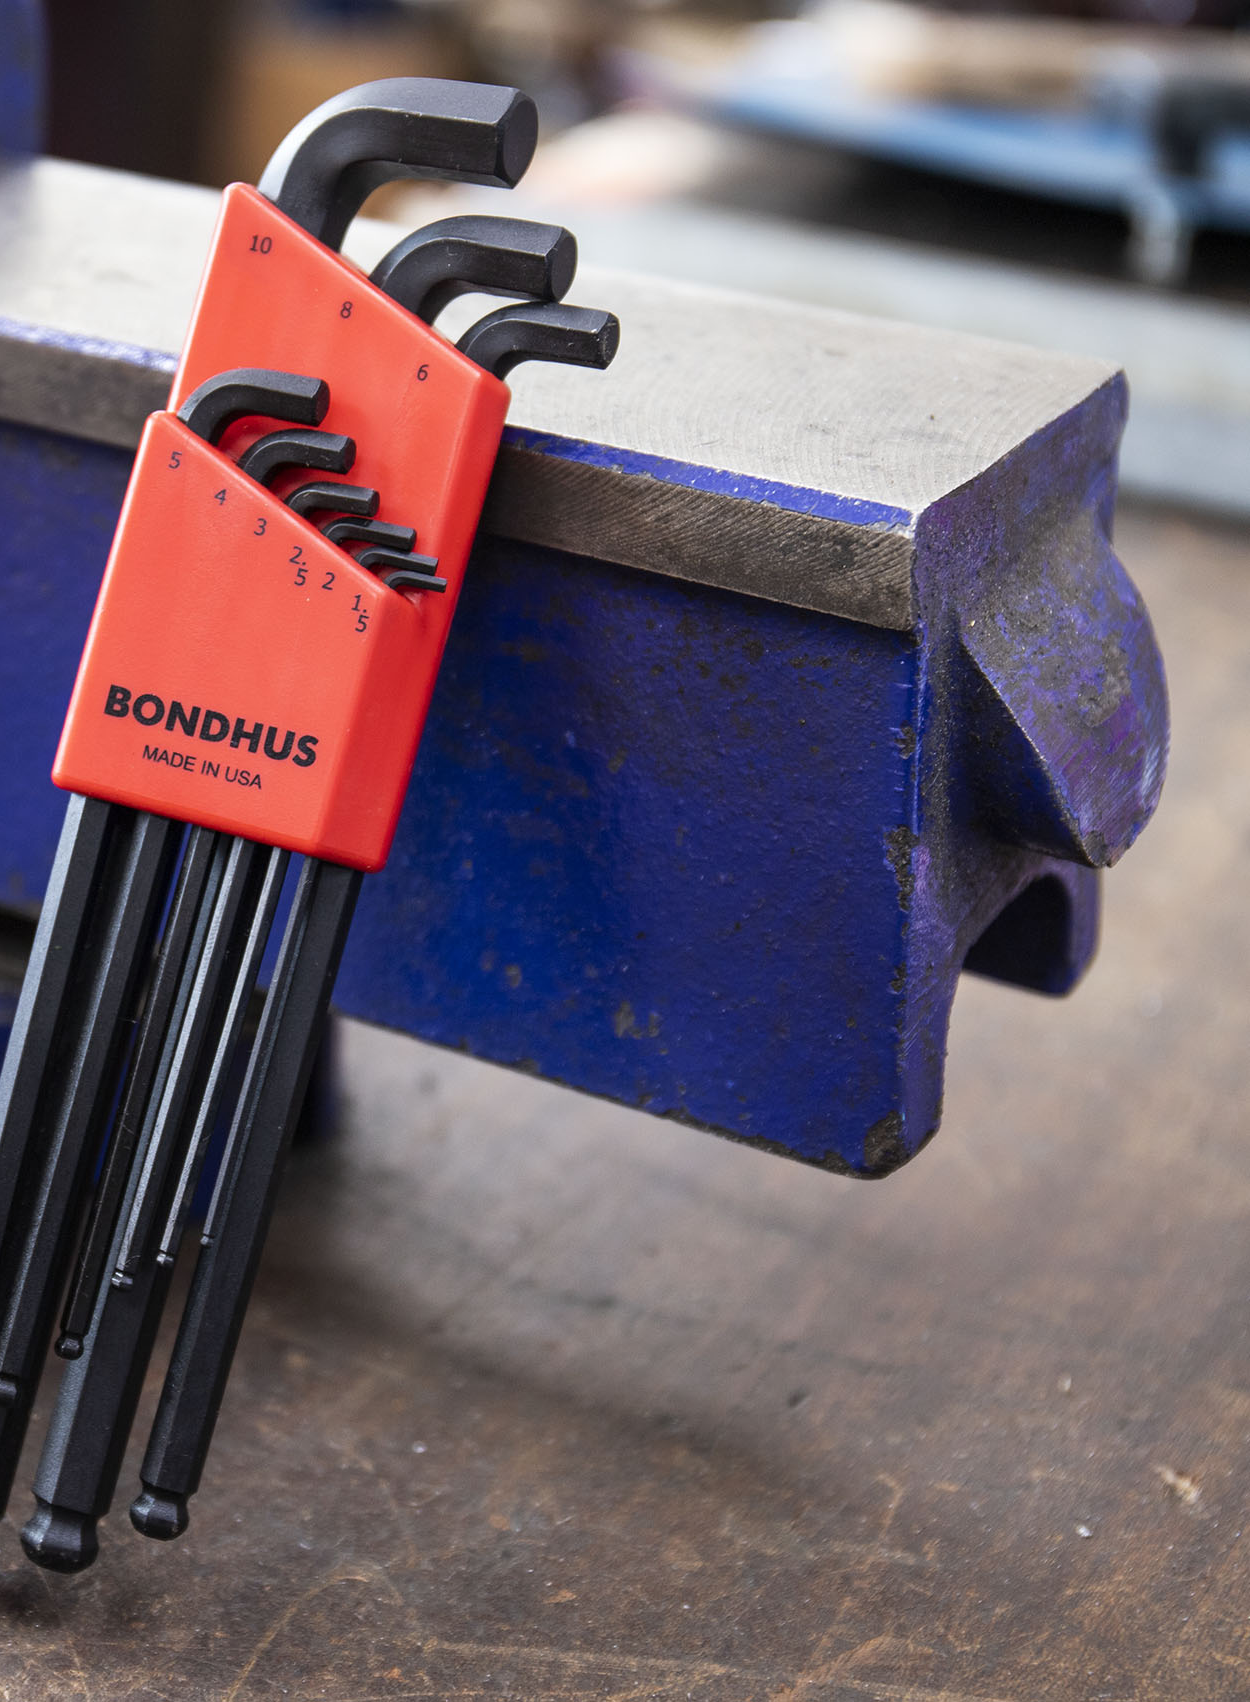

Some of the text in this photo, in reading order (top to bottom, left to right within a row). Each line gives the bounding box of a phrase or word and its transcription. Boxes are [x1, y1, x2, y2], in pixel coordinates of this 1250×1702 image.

[249, 235, 273, 255] 10
[340, 301, 353, 319] 8
[416, 364, 429, 382] 6
[168, 451, 182, 469] 5
[214, 488, 227, 505] 4
[253, 518, 267, 536] 3
[321, 572, 336, 590] 2
[103, 684, 319, 768] BONDHUS
[142, 745, 262, 789] MADE IN USA
